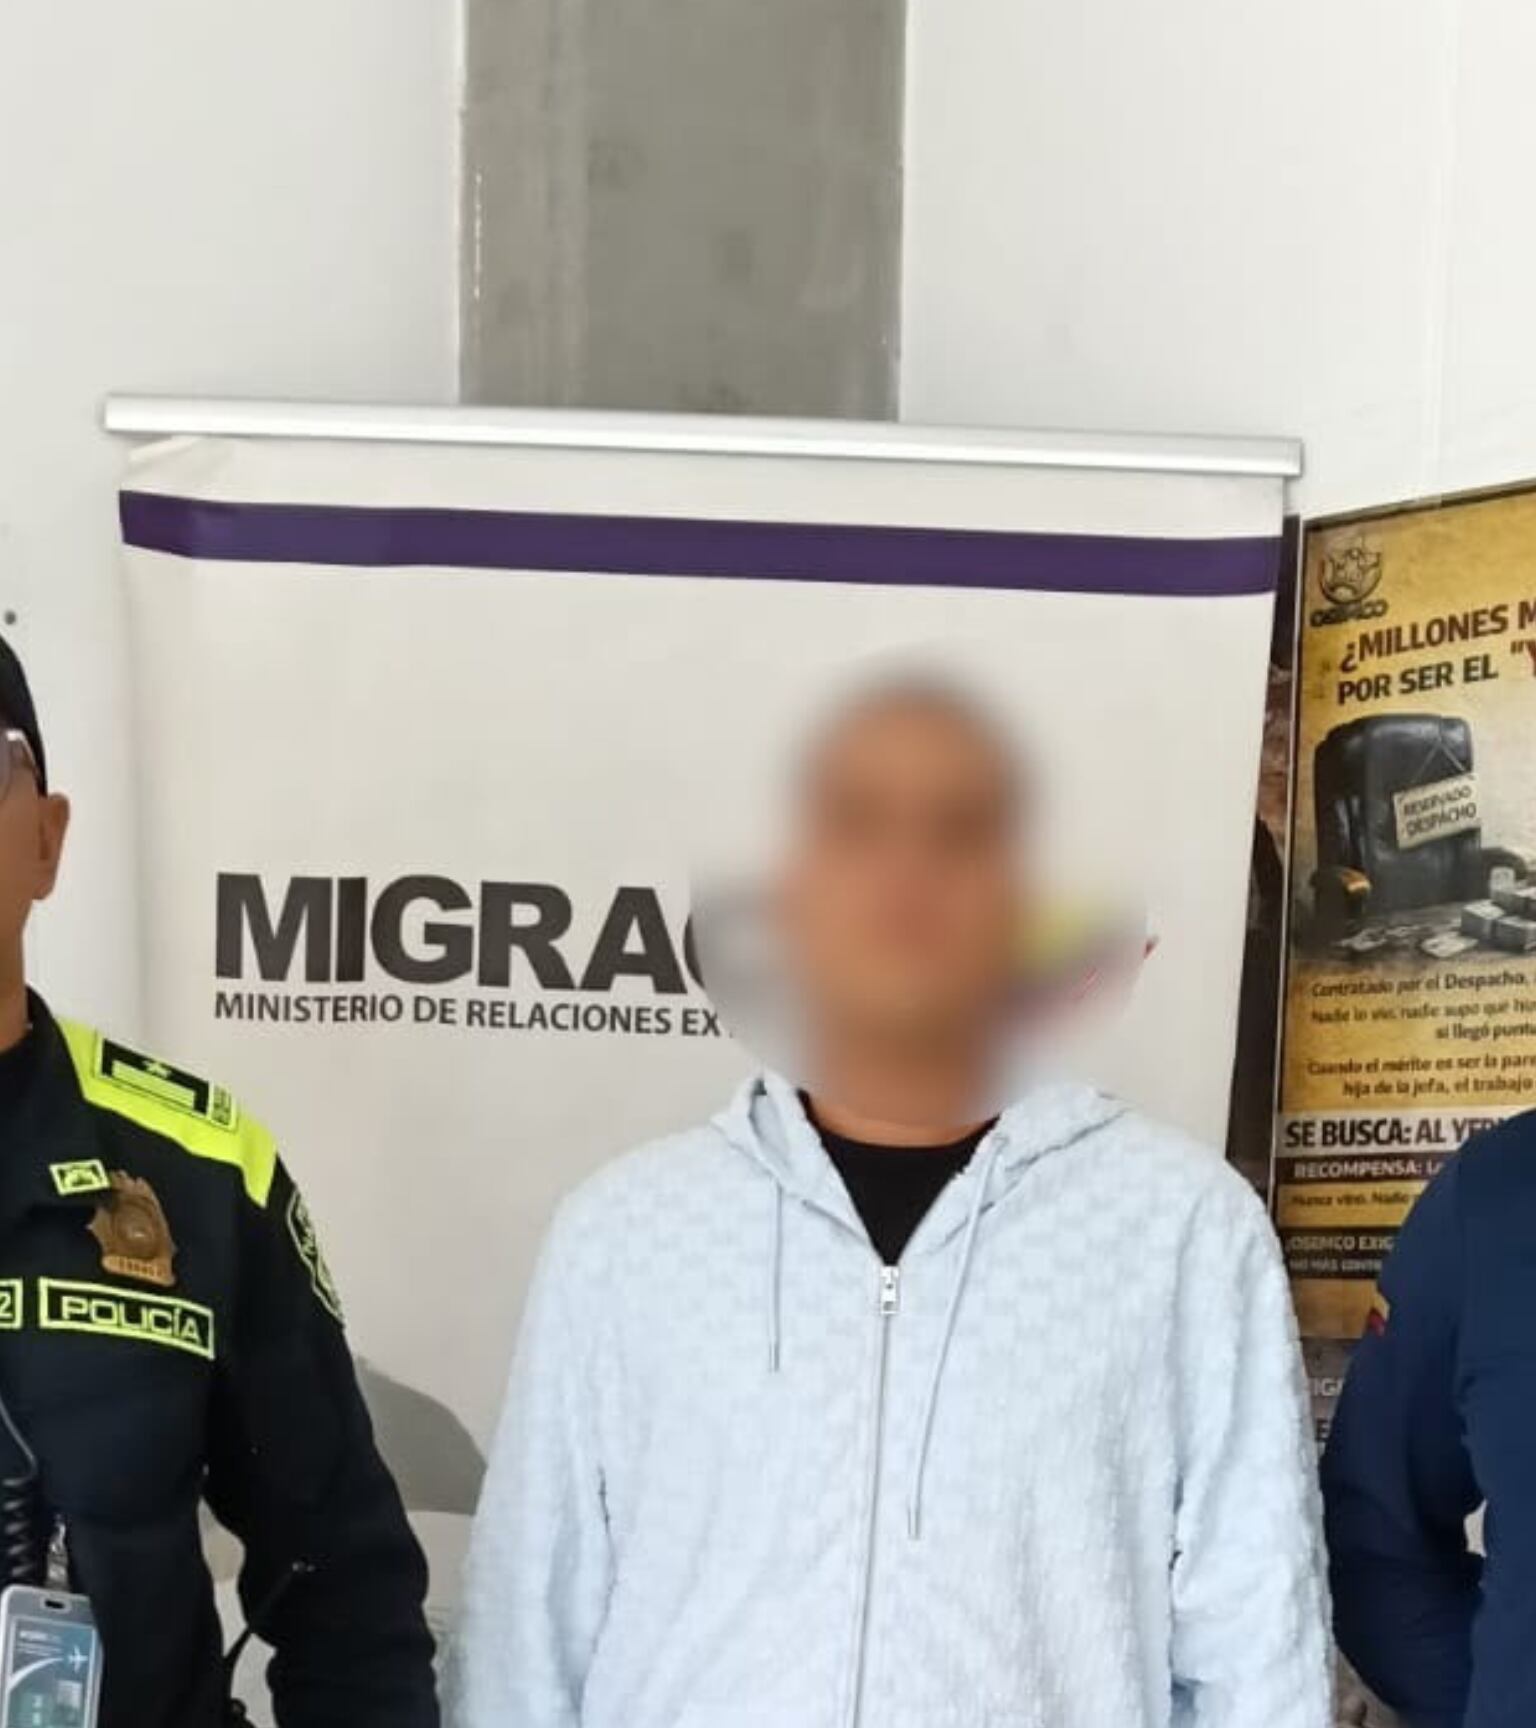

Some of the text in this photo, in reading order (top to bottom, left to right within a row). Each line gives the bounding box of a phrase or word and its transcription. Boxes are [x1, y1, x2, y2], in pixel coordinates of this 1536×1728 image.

[1340, 603, 1509, 674] ¿MILLONES
[1337, 673, 1392, 706] POR
[1399, 661, 1454, 694] SER
[1463, 653, 1499, 683] EL
[216, 873, 705, 994] MIGRA
[1397, 979, 1420, 995] por
[1425, 973, 1439, 990] el
[214, 991, 734, 1039] MINISTERIO DE RELACIONES EX
[1401, 1002, 1440, 1020] nadie
[1453, 1021, 1490, 1041] llegó
[1307, 1057, 1363, 1075] Cuando
[1365, 1056, 1379, 1073] el
[1435, 1057, 1453, 1070] es
[1456, 1057, 1482, 1069] ser
[1484, 1052, 1498, 1068] la
[1343, 1080, 1371, 1099] hija
[1374, 1079, 1392, 1095] de
[1396, 1079, 1410, 1094] la
[1454, 1076, 1469, 1093] el
[1473, 1073, 1534, 1094] trabajo
[1285, 1119, 1316, 1148] SE
[1321, 1117, 1411, 1147] BUSCA:
[1415, 1116, 1446, 1144] AL
[1294, 1160, 1422, 1179] RECOMPENSA:
[61, 1295, 200, 1343] POLICÍA
